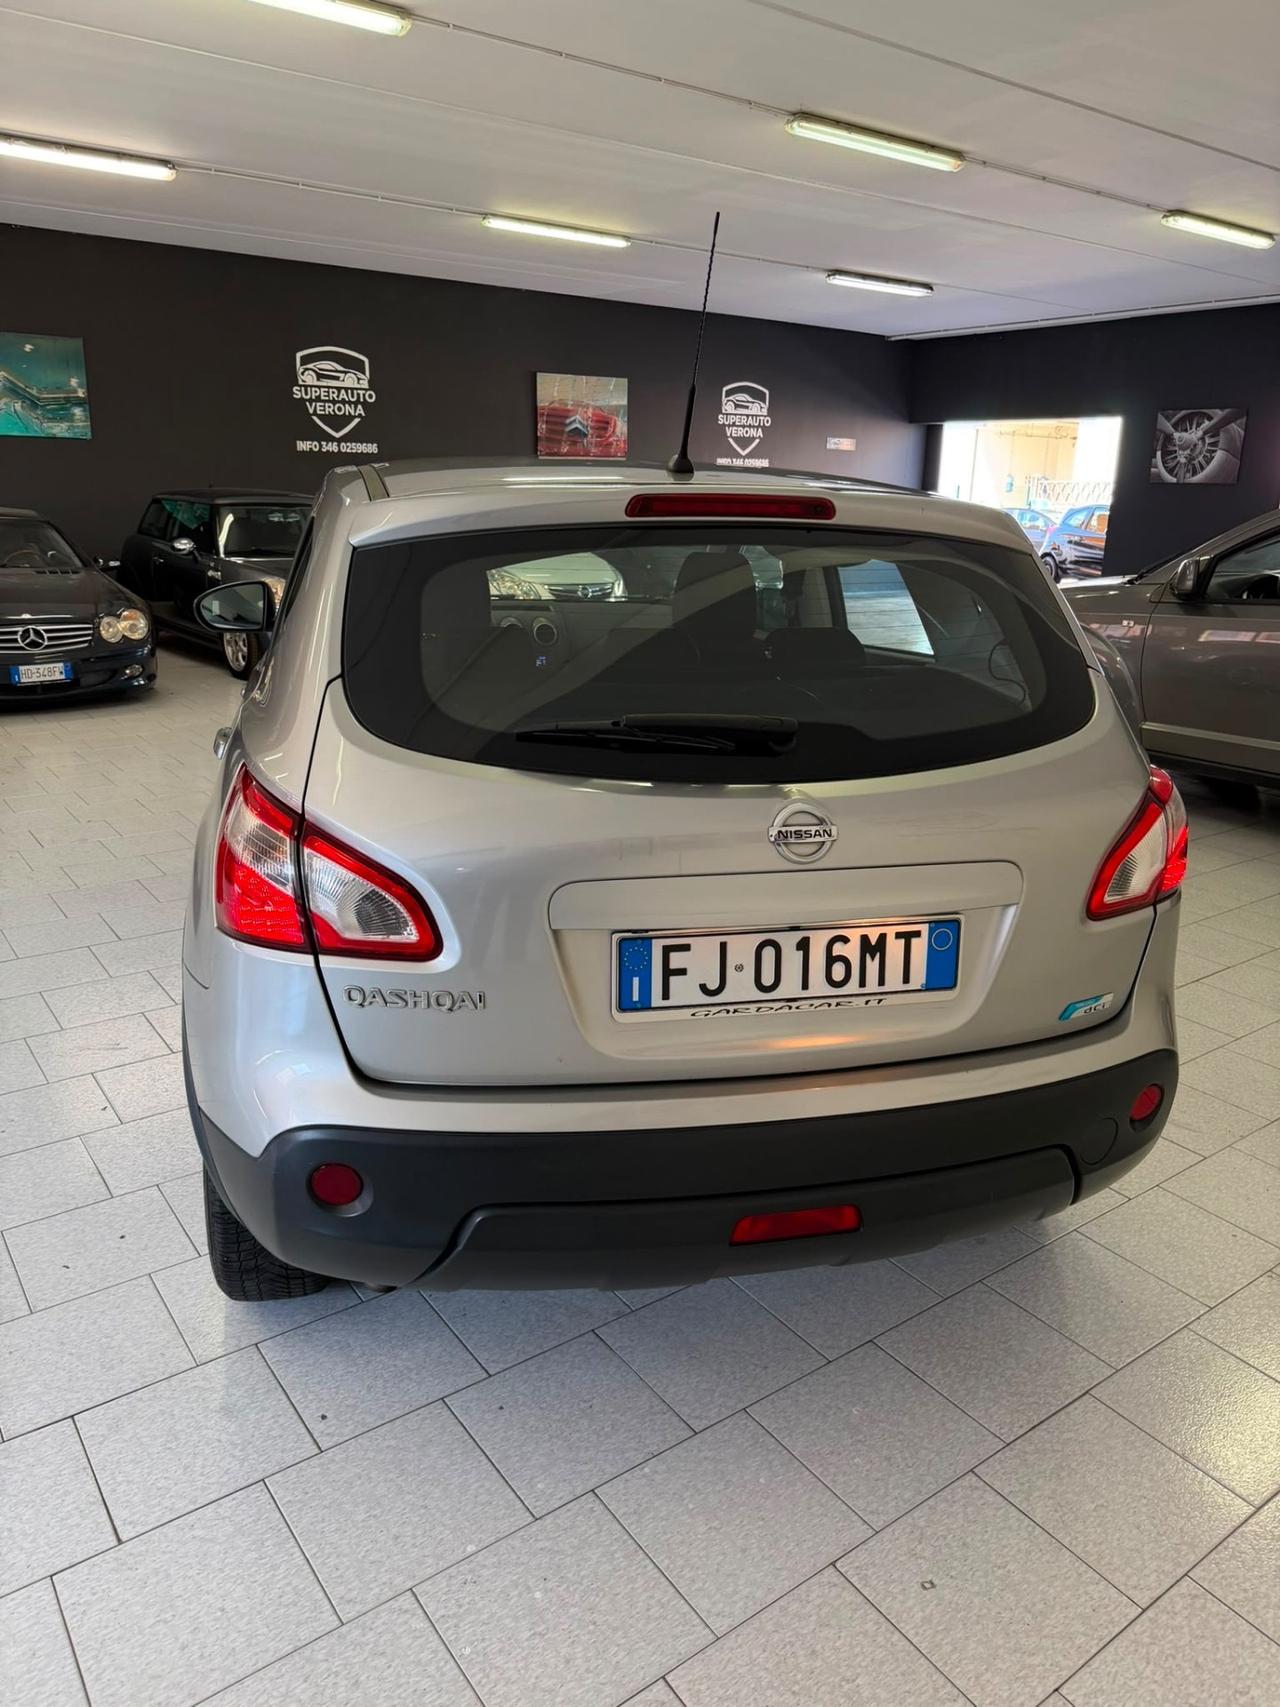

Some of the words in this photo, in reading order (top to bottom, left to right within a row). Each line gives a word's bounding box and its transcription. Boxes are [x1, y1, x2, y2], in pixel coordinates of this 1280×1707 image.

[292, 386, 376, 403] SUPERAUTO
[306, 402, 366, 417] VERONA
[718, 414, 772, 427] SUPERAUTO
[725, 426, 763, 438] VERONA
[296, 440, 320, 452] INFO
[321, 441, 339, 453] 346
[340, 442, 378, 454] 0259686
[777, 828, 832, 839] NISSAN
[342, 984, 486, 1013] QASHQAI
